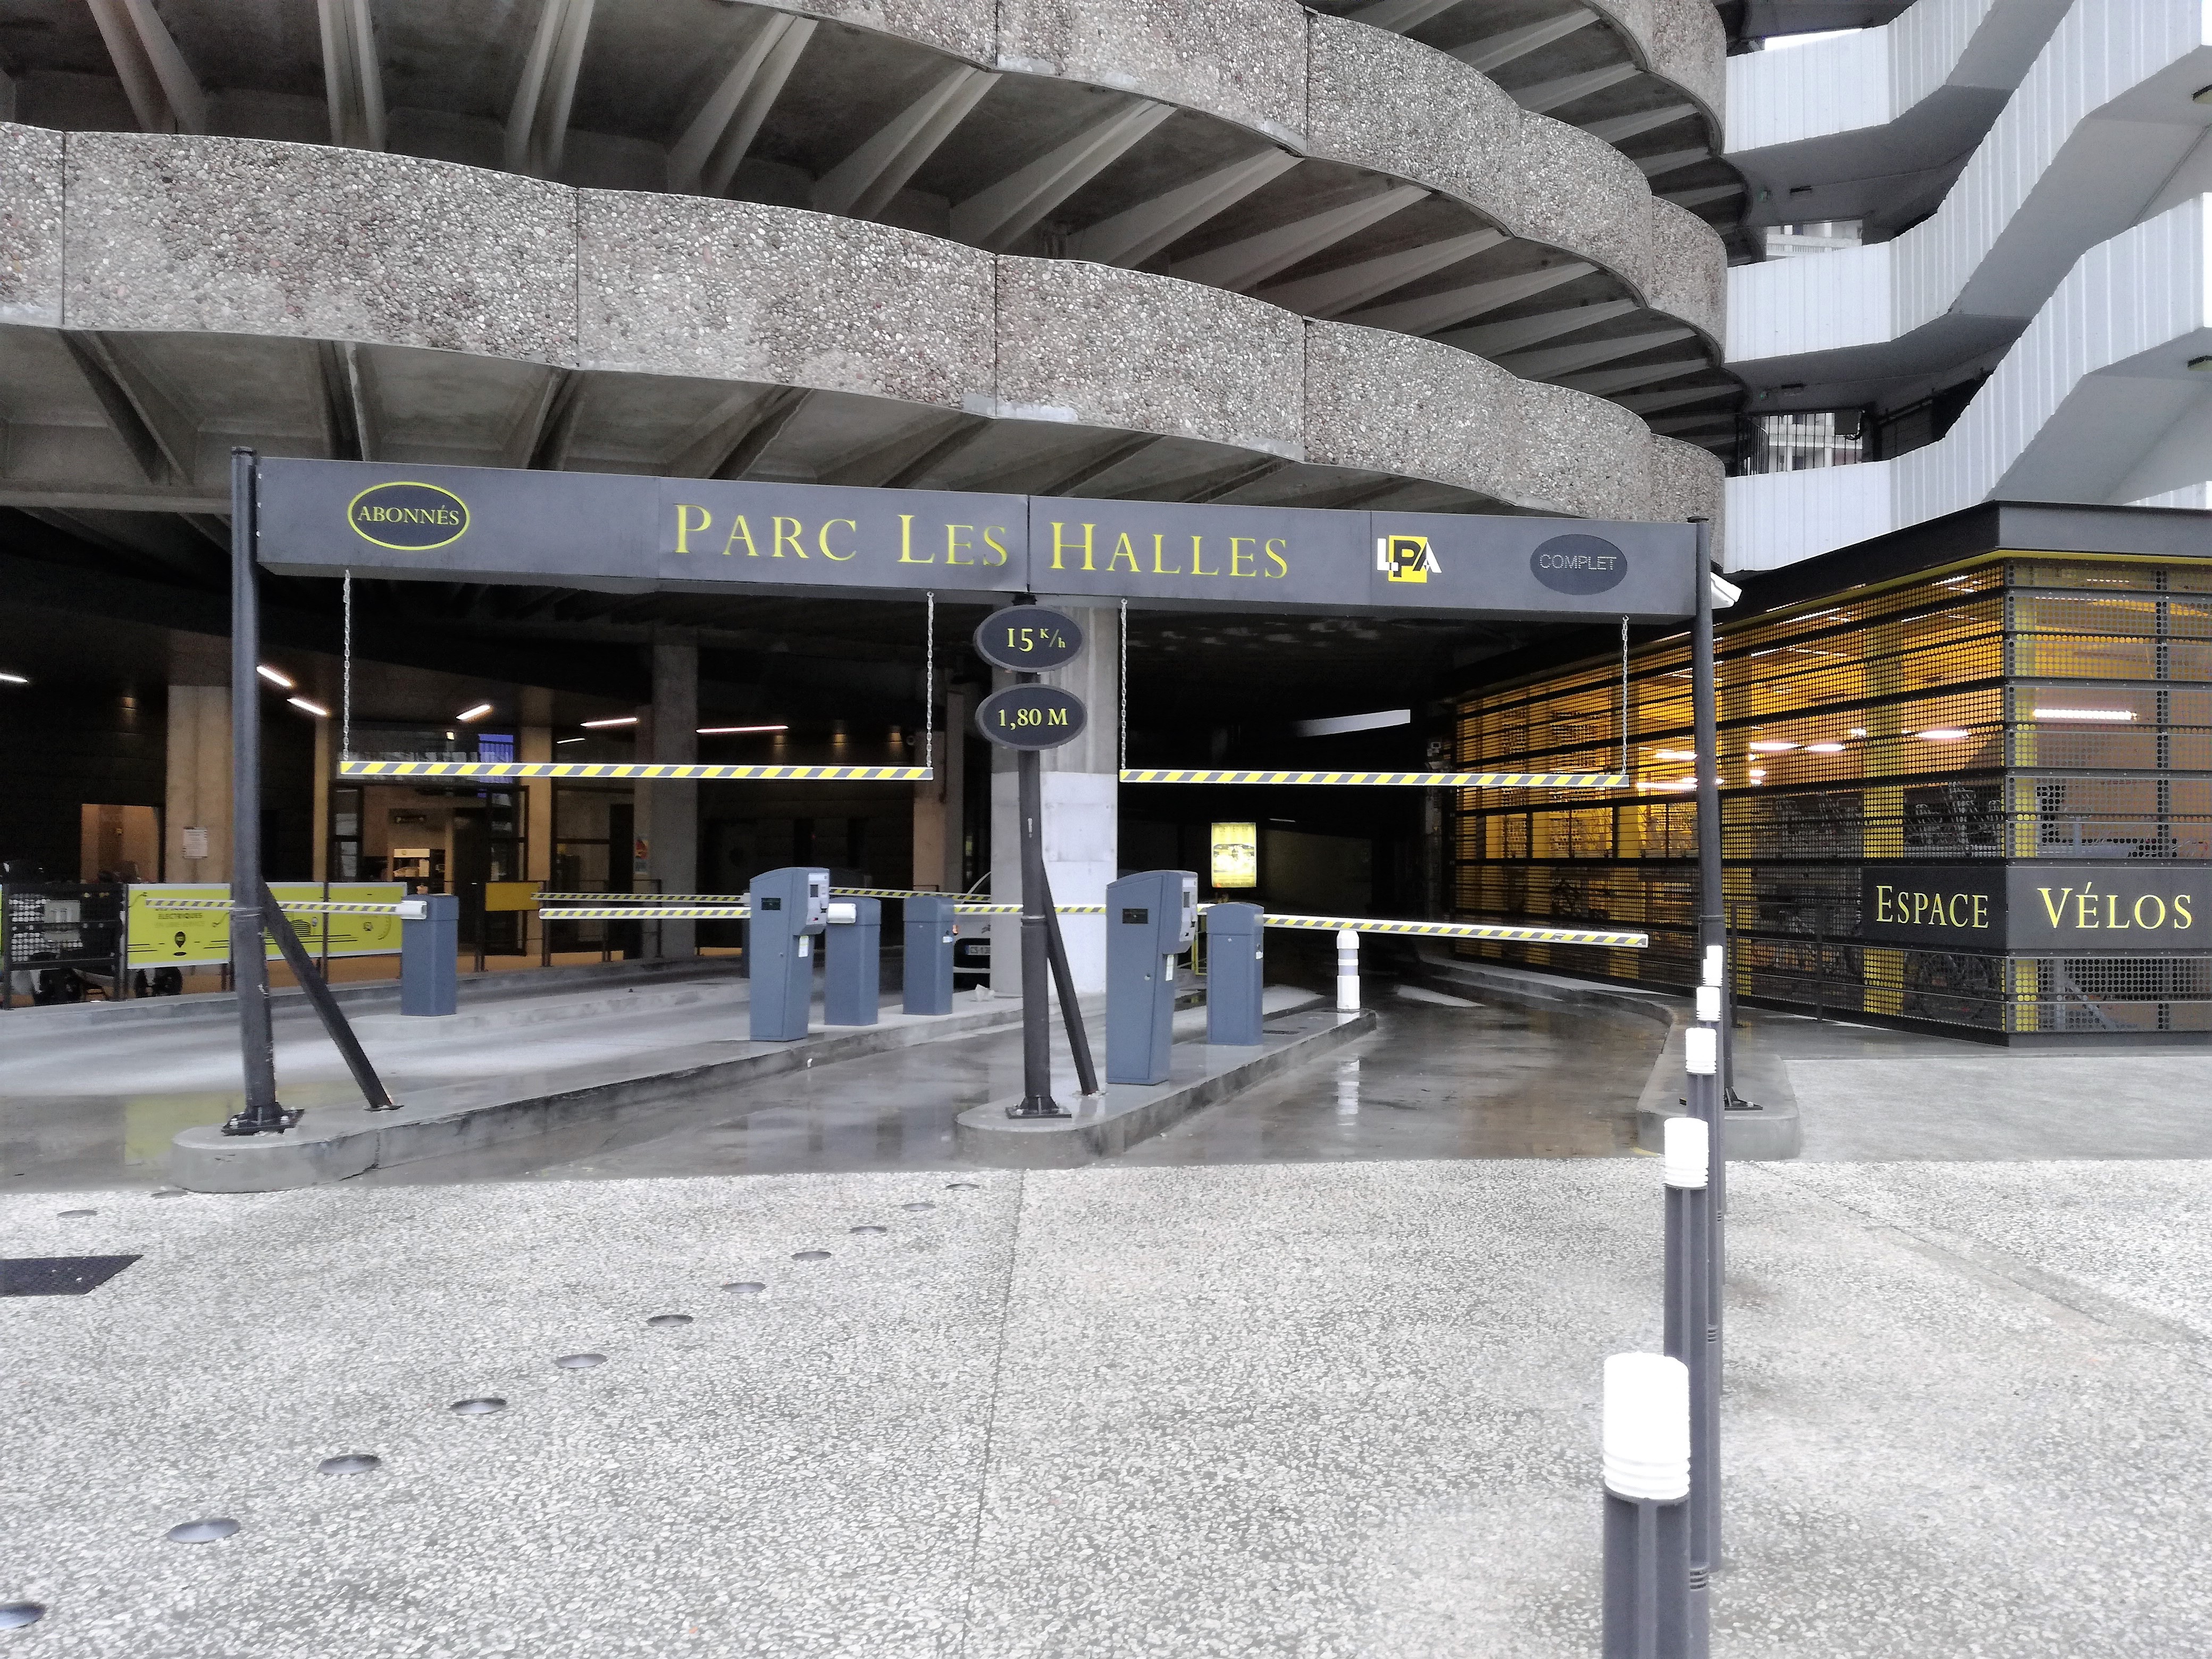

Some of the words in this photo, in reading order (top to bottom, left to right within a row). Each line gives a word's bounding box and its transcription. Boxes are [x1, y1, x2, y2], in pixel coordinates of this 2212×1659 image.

[357, 505, 460, 526] ABONNÉS
[675, 503, 857, 562] PARC
[897, 514, 1008, 567] LES
[1050, 522, 1288, 579] HALLES
[1377, 538, 1442, 579] LPA
[1539, 554, 1617, 571] COMPLET
[998, 708, 1043, 731] 1,80
[1048, 708, 1068, 726] M
[1875, 885, 1990, 929] ESPACE
[2037, 881, 2194, 930] VÉLOS
